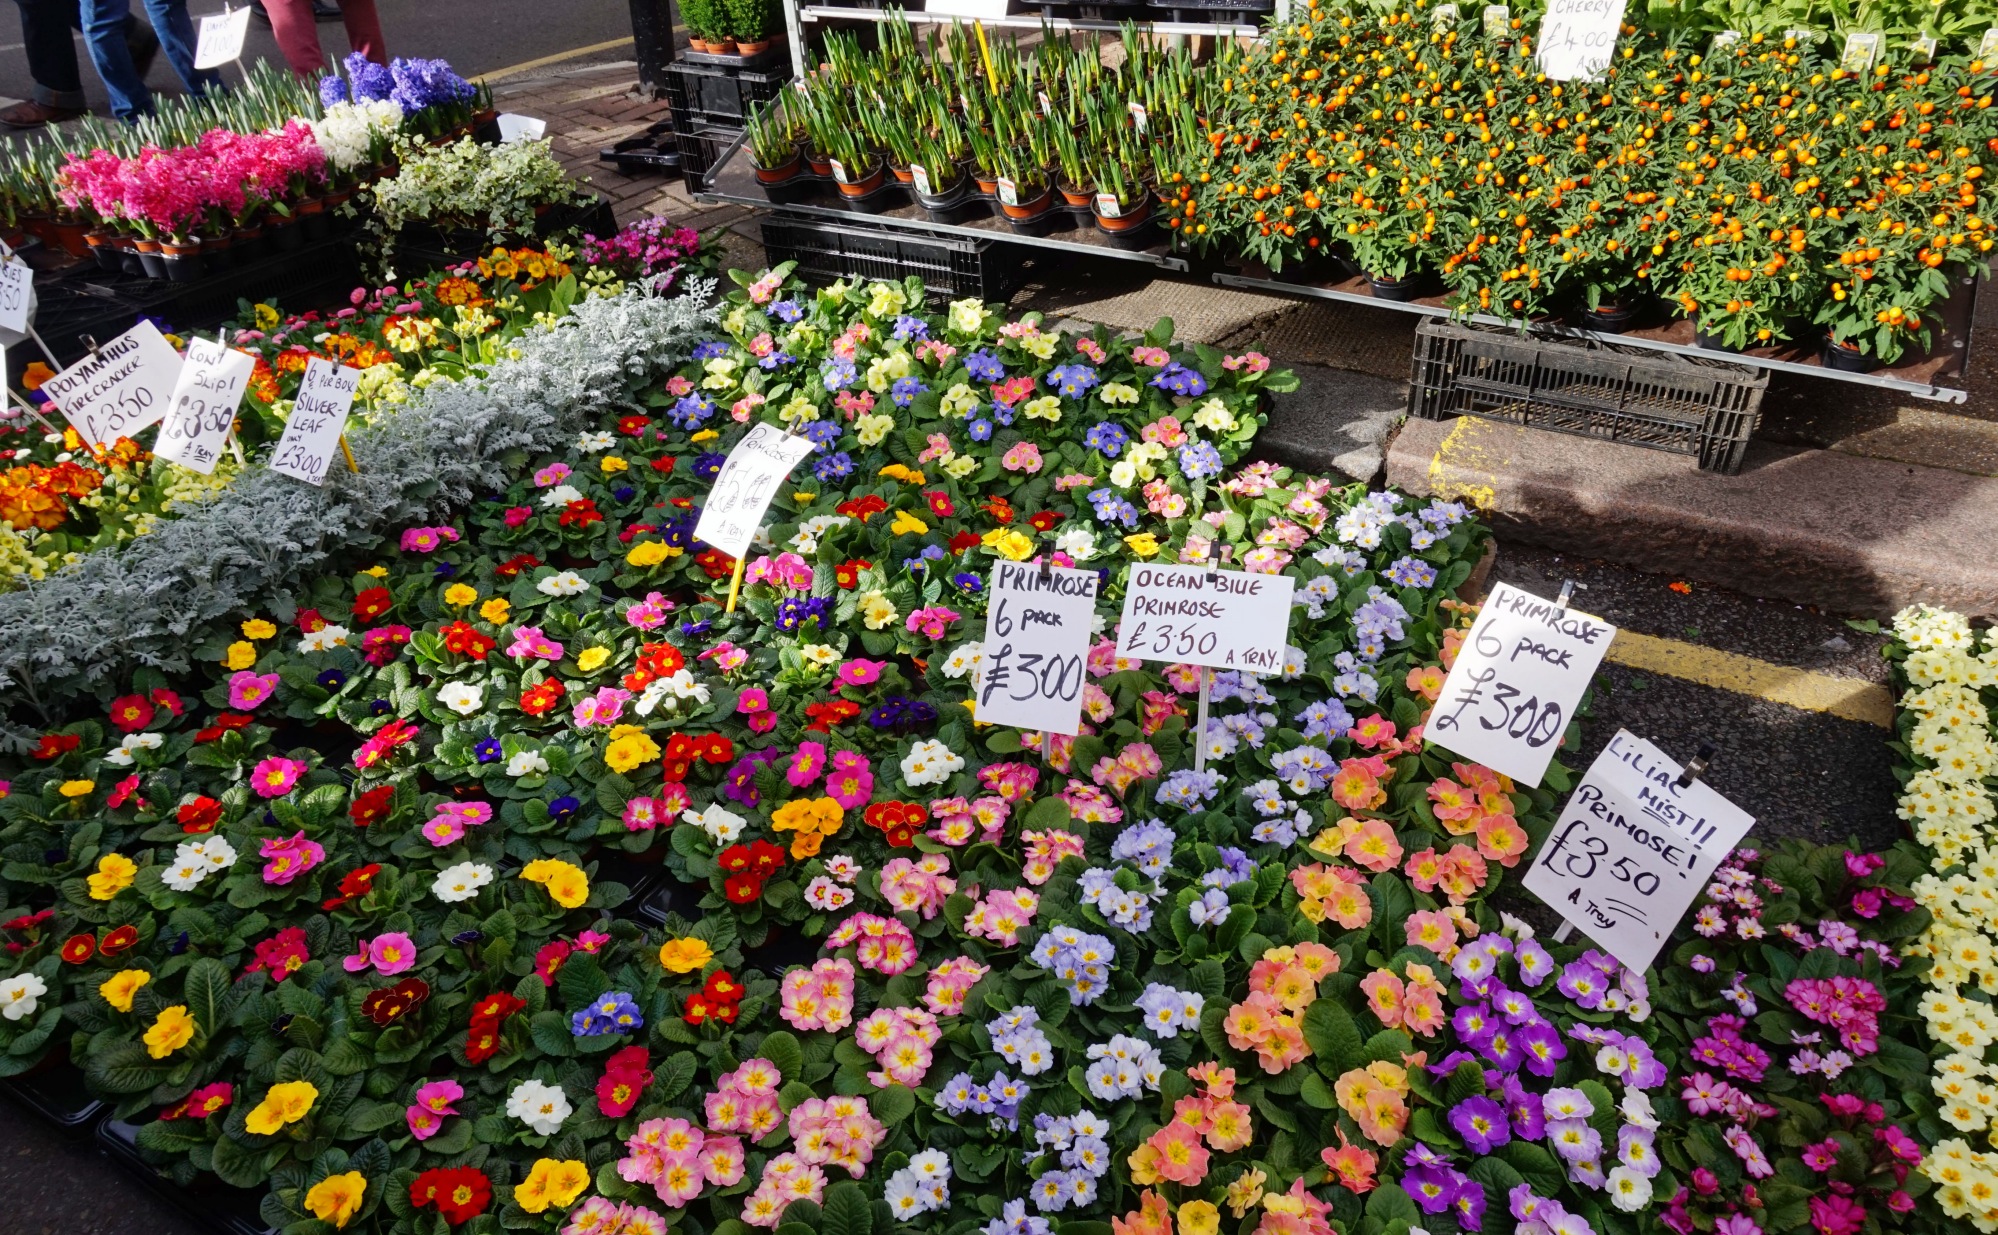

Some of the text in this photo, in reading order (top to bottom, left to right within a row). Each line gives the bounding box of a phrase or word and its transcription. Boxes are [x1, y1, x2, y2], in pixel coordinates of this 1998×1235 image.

[1556, 0, 1614, 19] CHERRY
[1577, 55, 1585, 69] A
[48, 335, 139, 399] POLYANTHUS
[308, 362, 355, 393] 6 PER BOX
[65, 355, 144, 416] FIRECRACKER
[86, 387, 153, 443] £3.50
[165, 395, 233, 440] £3.50
[293, 416, 327, 433] LEAF
[185, 441, 215, 462] A TRAY
[287, 434, 303, 442] ONLY
[275, 445, 322, 474] £3.00
[719, 520, 727, 530] A
[998, 564, 1098, 598] PRIMROSE
[1136, 569, 1206, 591] OCEAN
[995, 598, 1063, 637] 6 PACK
[1134, 596, 1225, 618] PRIMROSE
[1126, 621, 1217, 656] £3.50
[1475, 618, 1574, 669] 6 PACK
[1225, 650, 1234, 664] A
[1541, 818, 1662, 896] £3.50
[1568, 887, 1581, 905] A
